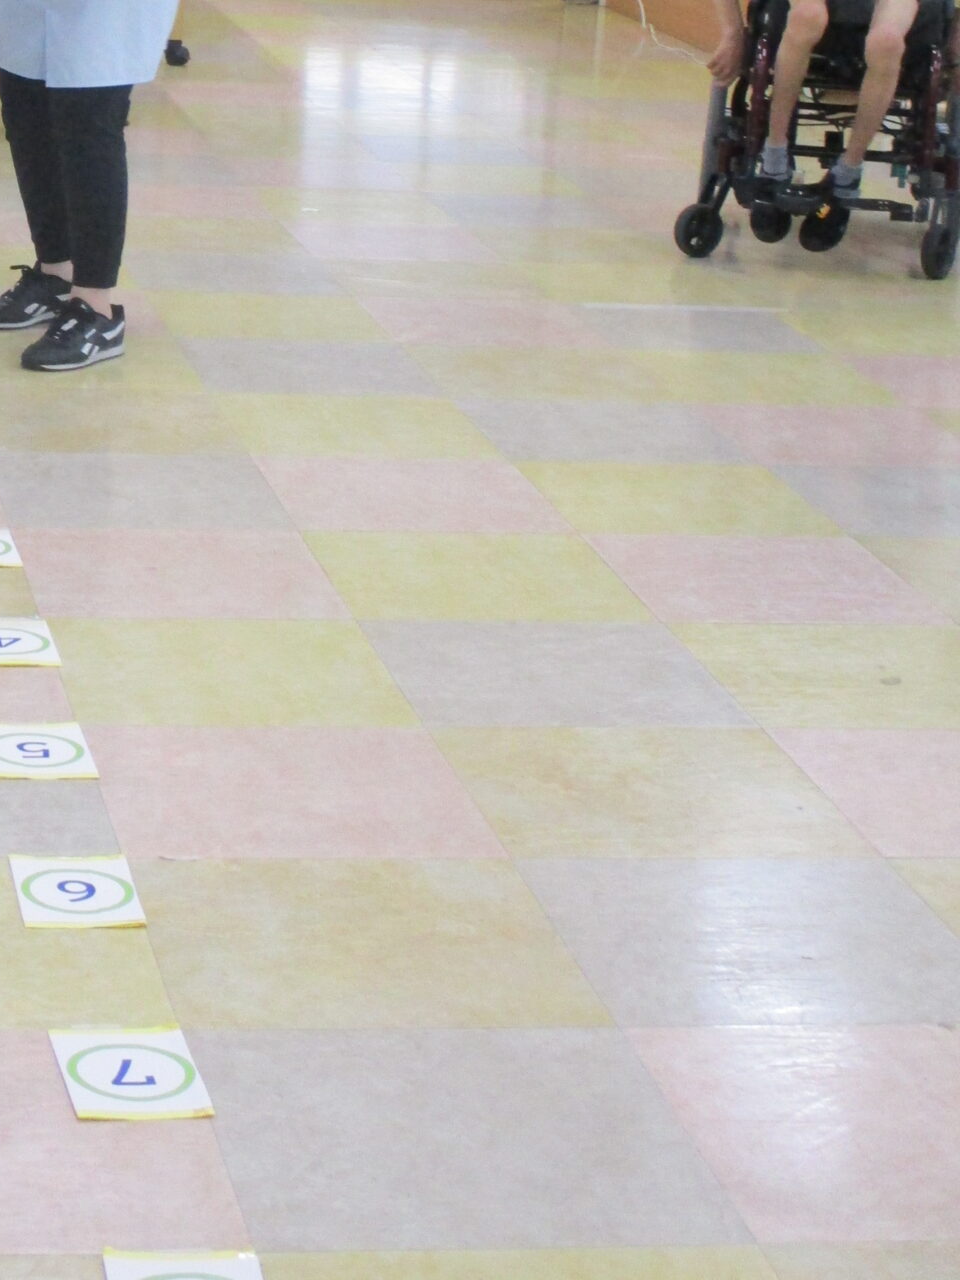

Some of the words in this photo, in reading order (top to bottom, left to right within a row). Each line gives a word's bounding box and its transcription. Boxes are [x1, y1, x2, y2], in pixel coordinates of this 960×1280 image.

[15, 741, 51, 760] 5
[56, 880, 97, 903] 6
[111, 1058, 157, 1087] 7
